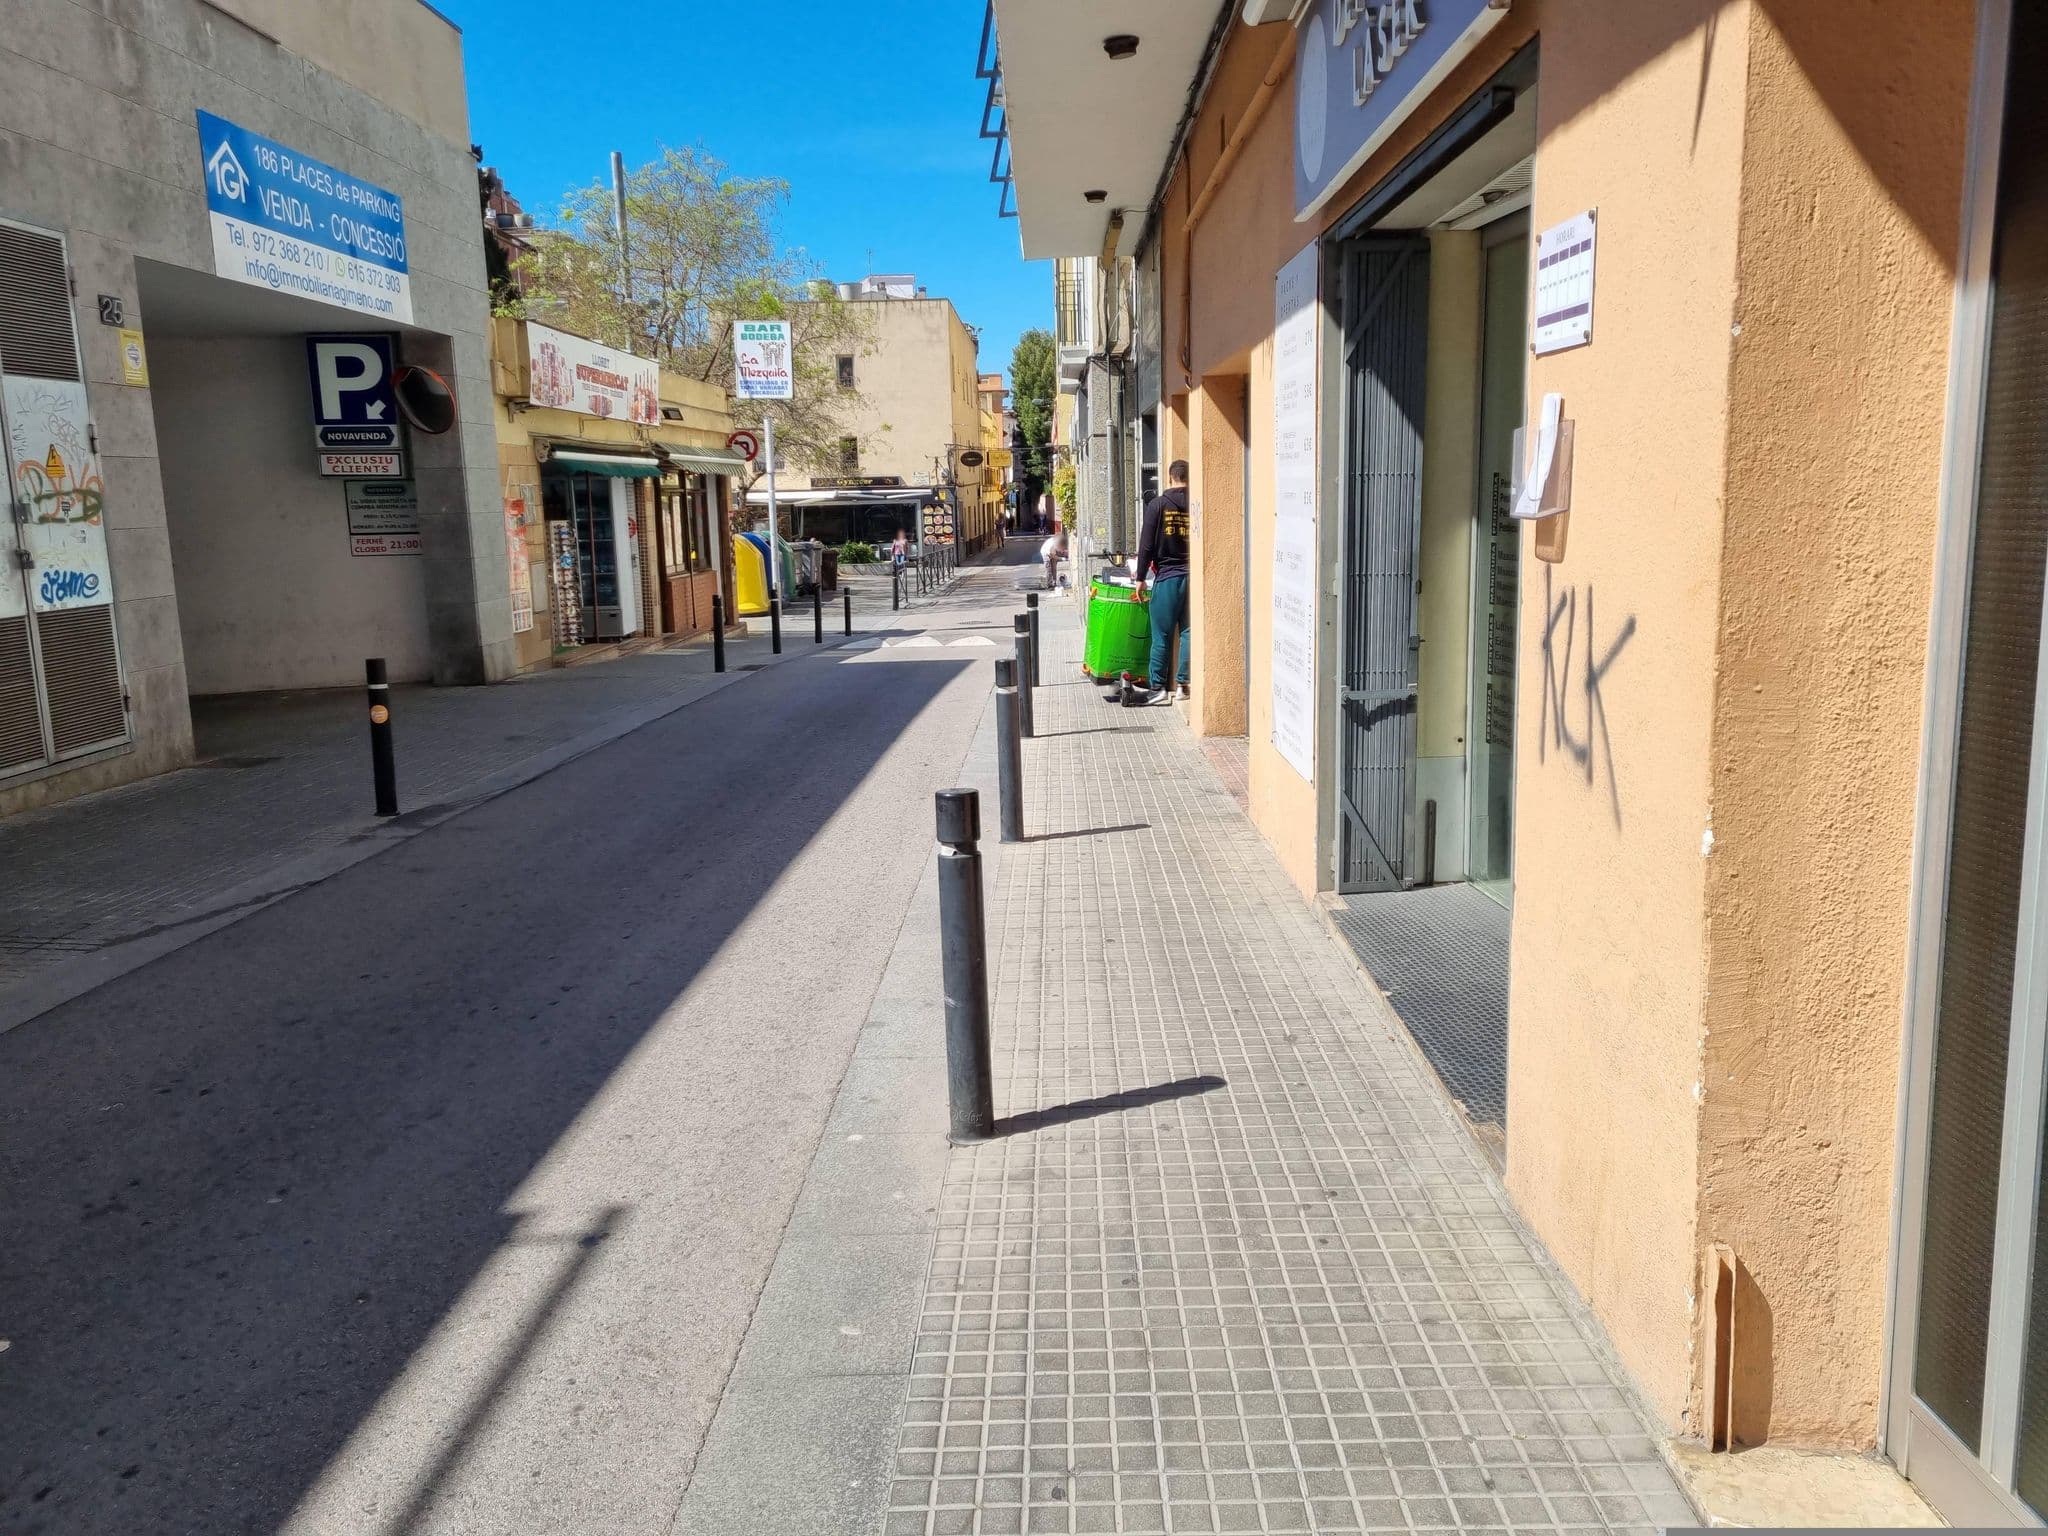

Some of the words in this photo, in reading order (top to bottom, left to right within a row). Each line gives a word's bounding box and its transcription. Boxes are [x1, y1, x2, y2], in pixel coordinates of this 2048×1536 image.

[254, 144, 279, 174] 186
[281, 155, 333, 196] PLACES
[335, 180, 350, 202] de
[351, 185, 400, 222] PARKING
[258, 185, 315, 232] VENDA
[331, 213, 405, 263] CONCESSIÓ
[225, 222, 249, 249] Tel.
[253, 231, 276, 256] 972
[279, 239, 301, 264] 368
[304, 250, 324, 271] 210
[348, 261, 365, 282] 615
[367, 268, 384, 289] 372
[384, 273, 401, 294] 903
[245, 256, 394, 314] info@immobiliariagimeno.com
[101, 298, 123, 324] 25
[744, 324, 782, 332] BAR
[741, 353, 759, 365] La
[315, 343, 383, 420] P
[327, 432, 387, 440] NOVAVENDA
[326, 456, 393, 465] EXCLUSIU
[332, 465, 389, 473] CLIENTS
